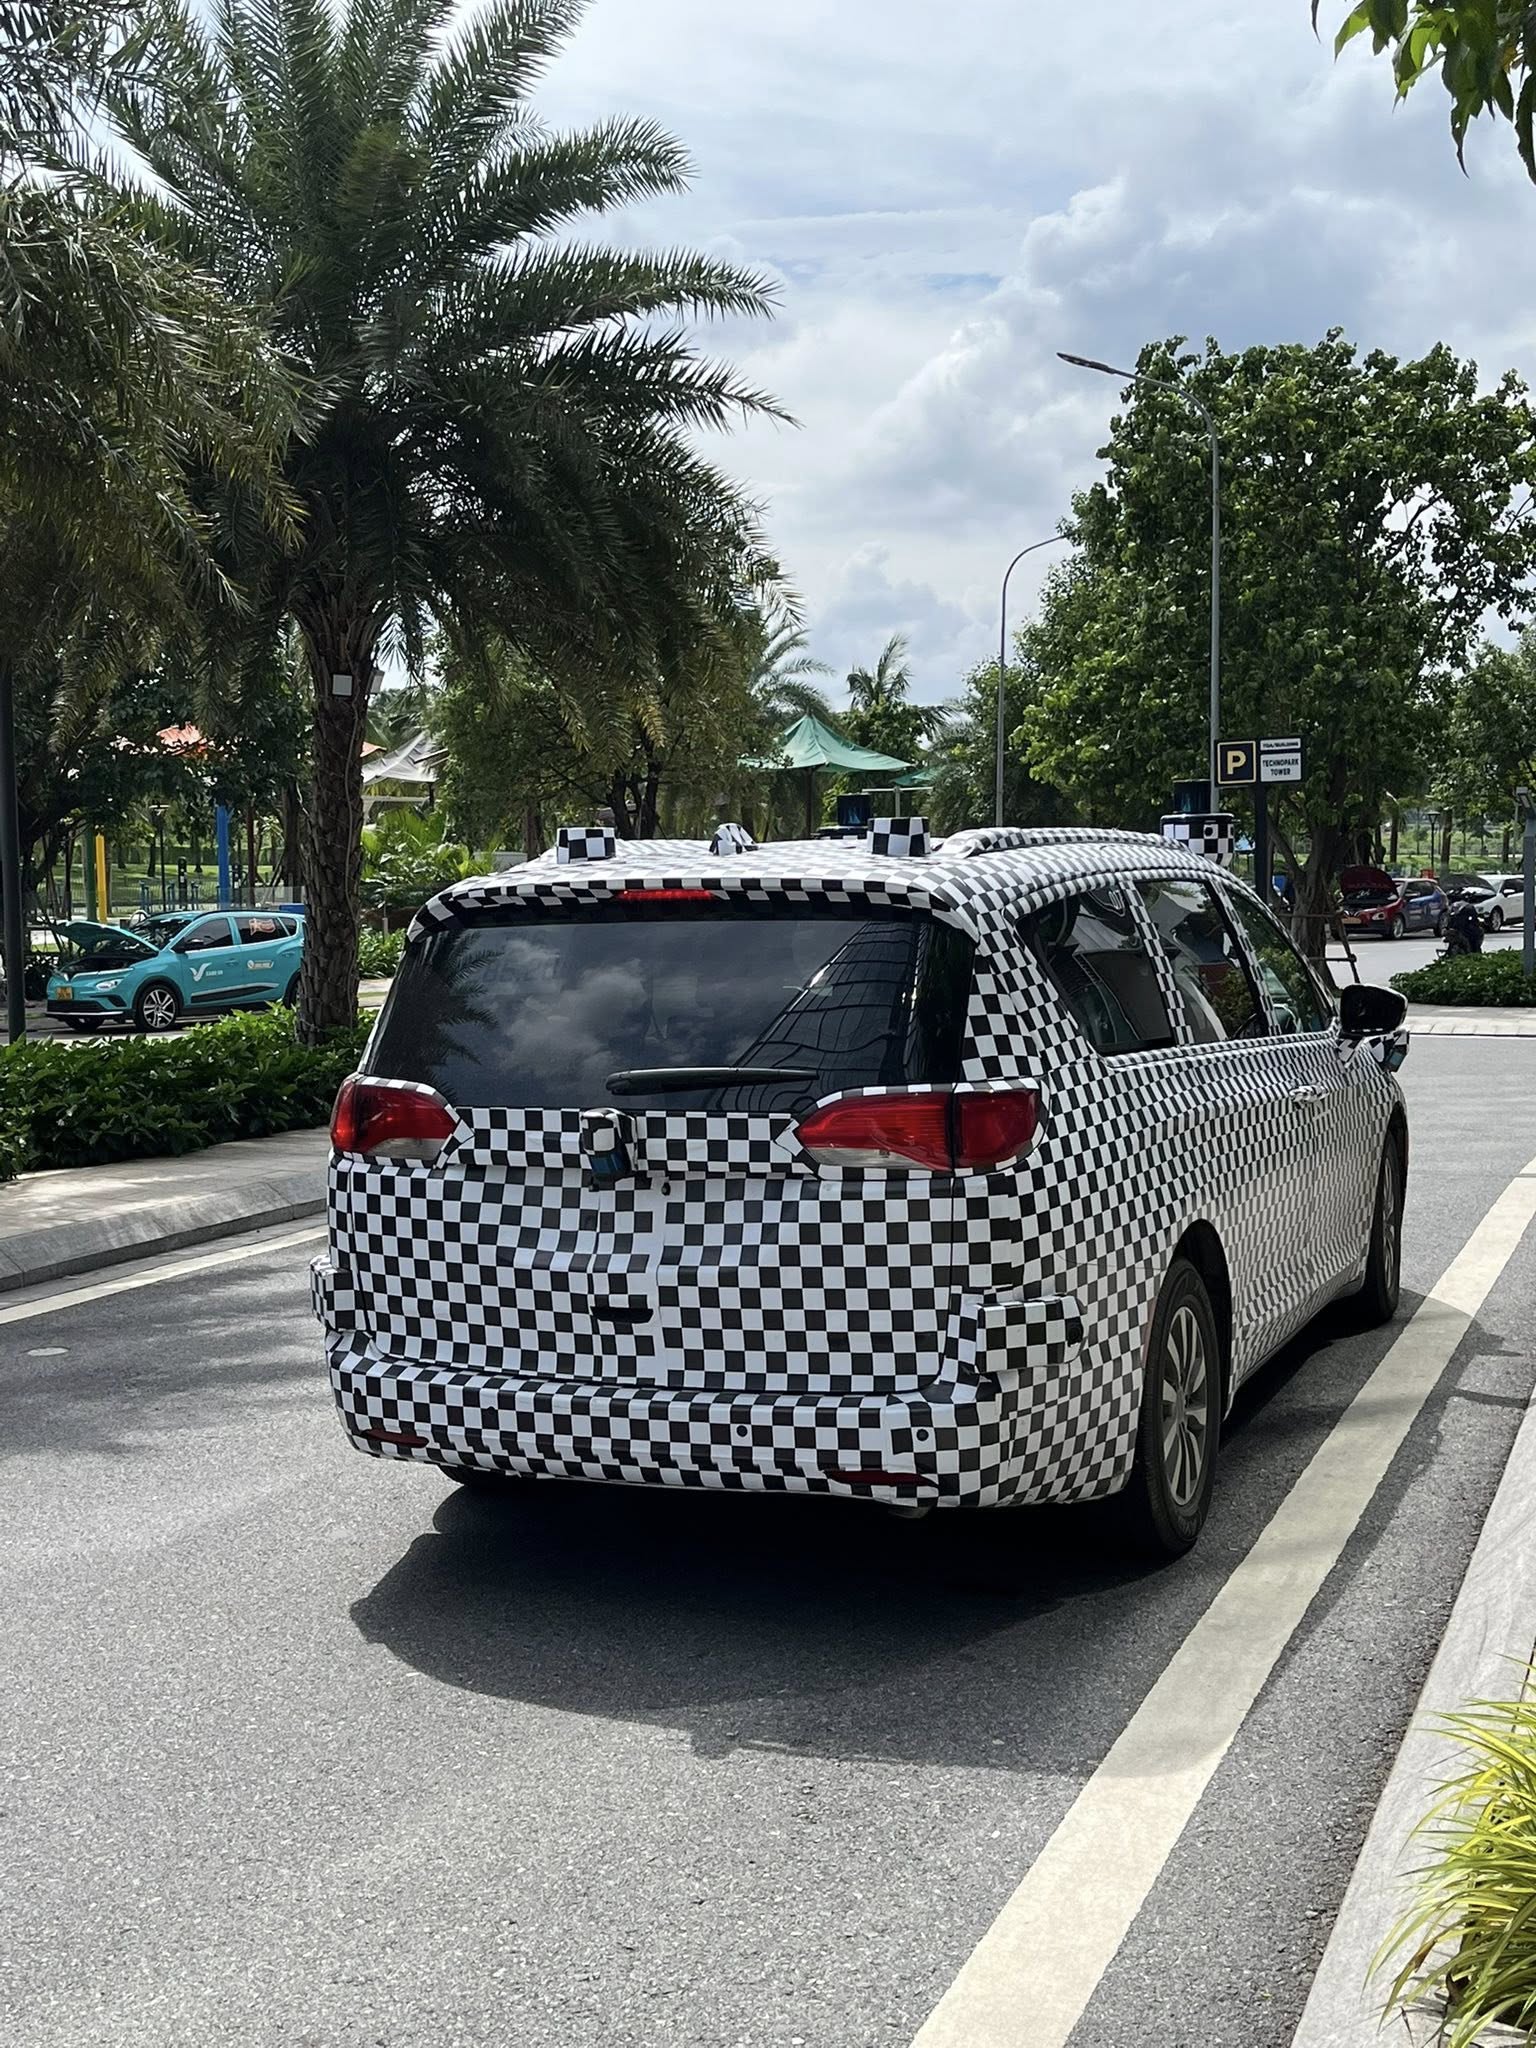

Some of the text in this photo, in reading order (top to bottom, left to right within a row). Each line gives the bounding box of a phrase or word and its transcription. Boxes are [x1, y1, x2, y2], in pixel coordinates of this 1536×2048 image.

[1227, 750, 1246, 775] P
[1262, 758, 1299, 767] TECHNOPARK
[1270, 768, 1291, 776] TOWER
